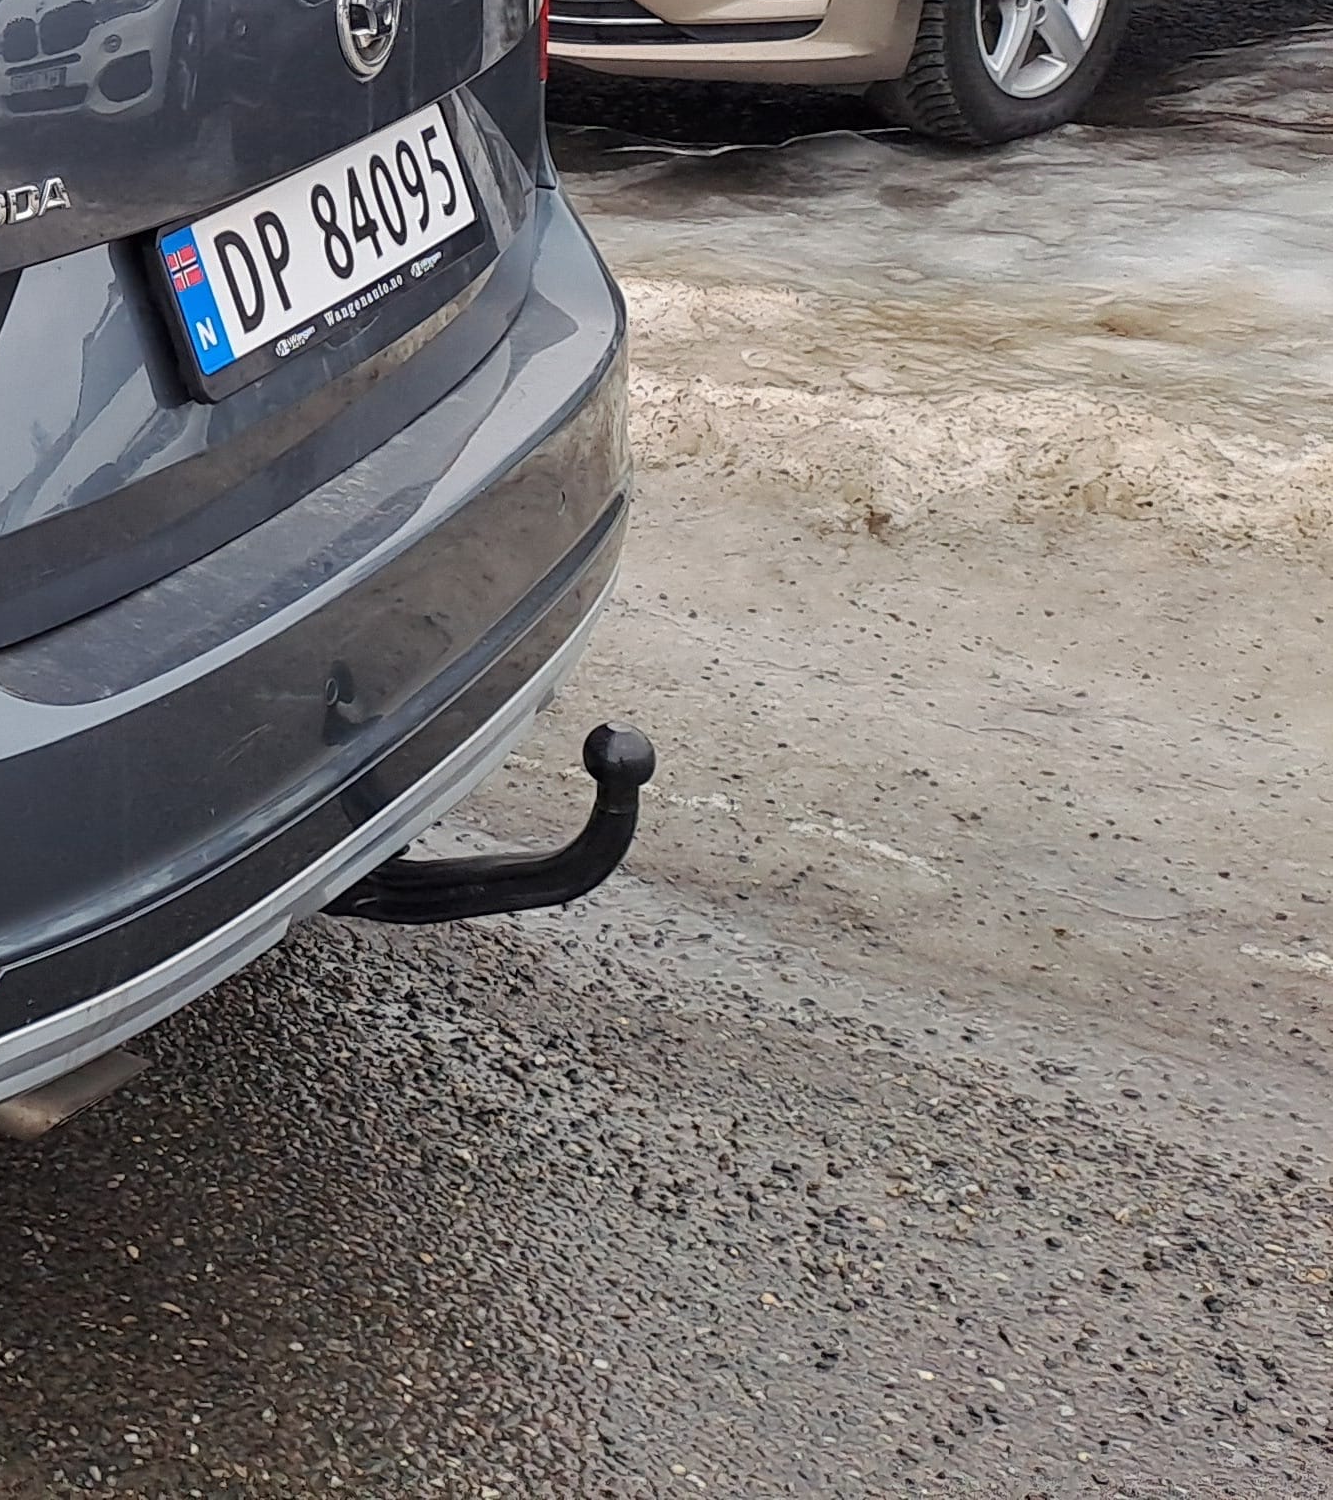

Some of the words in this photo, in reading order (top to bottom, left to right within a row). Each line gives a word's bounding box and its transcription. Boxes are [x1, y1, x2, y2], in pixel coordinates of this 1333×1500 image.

[214, 211, 292, 334] DP
[311, 125, 457, 280] 84095
[196, 316, 218, 350] N
